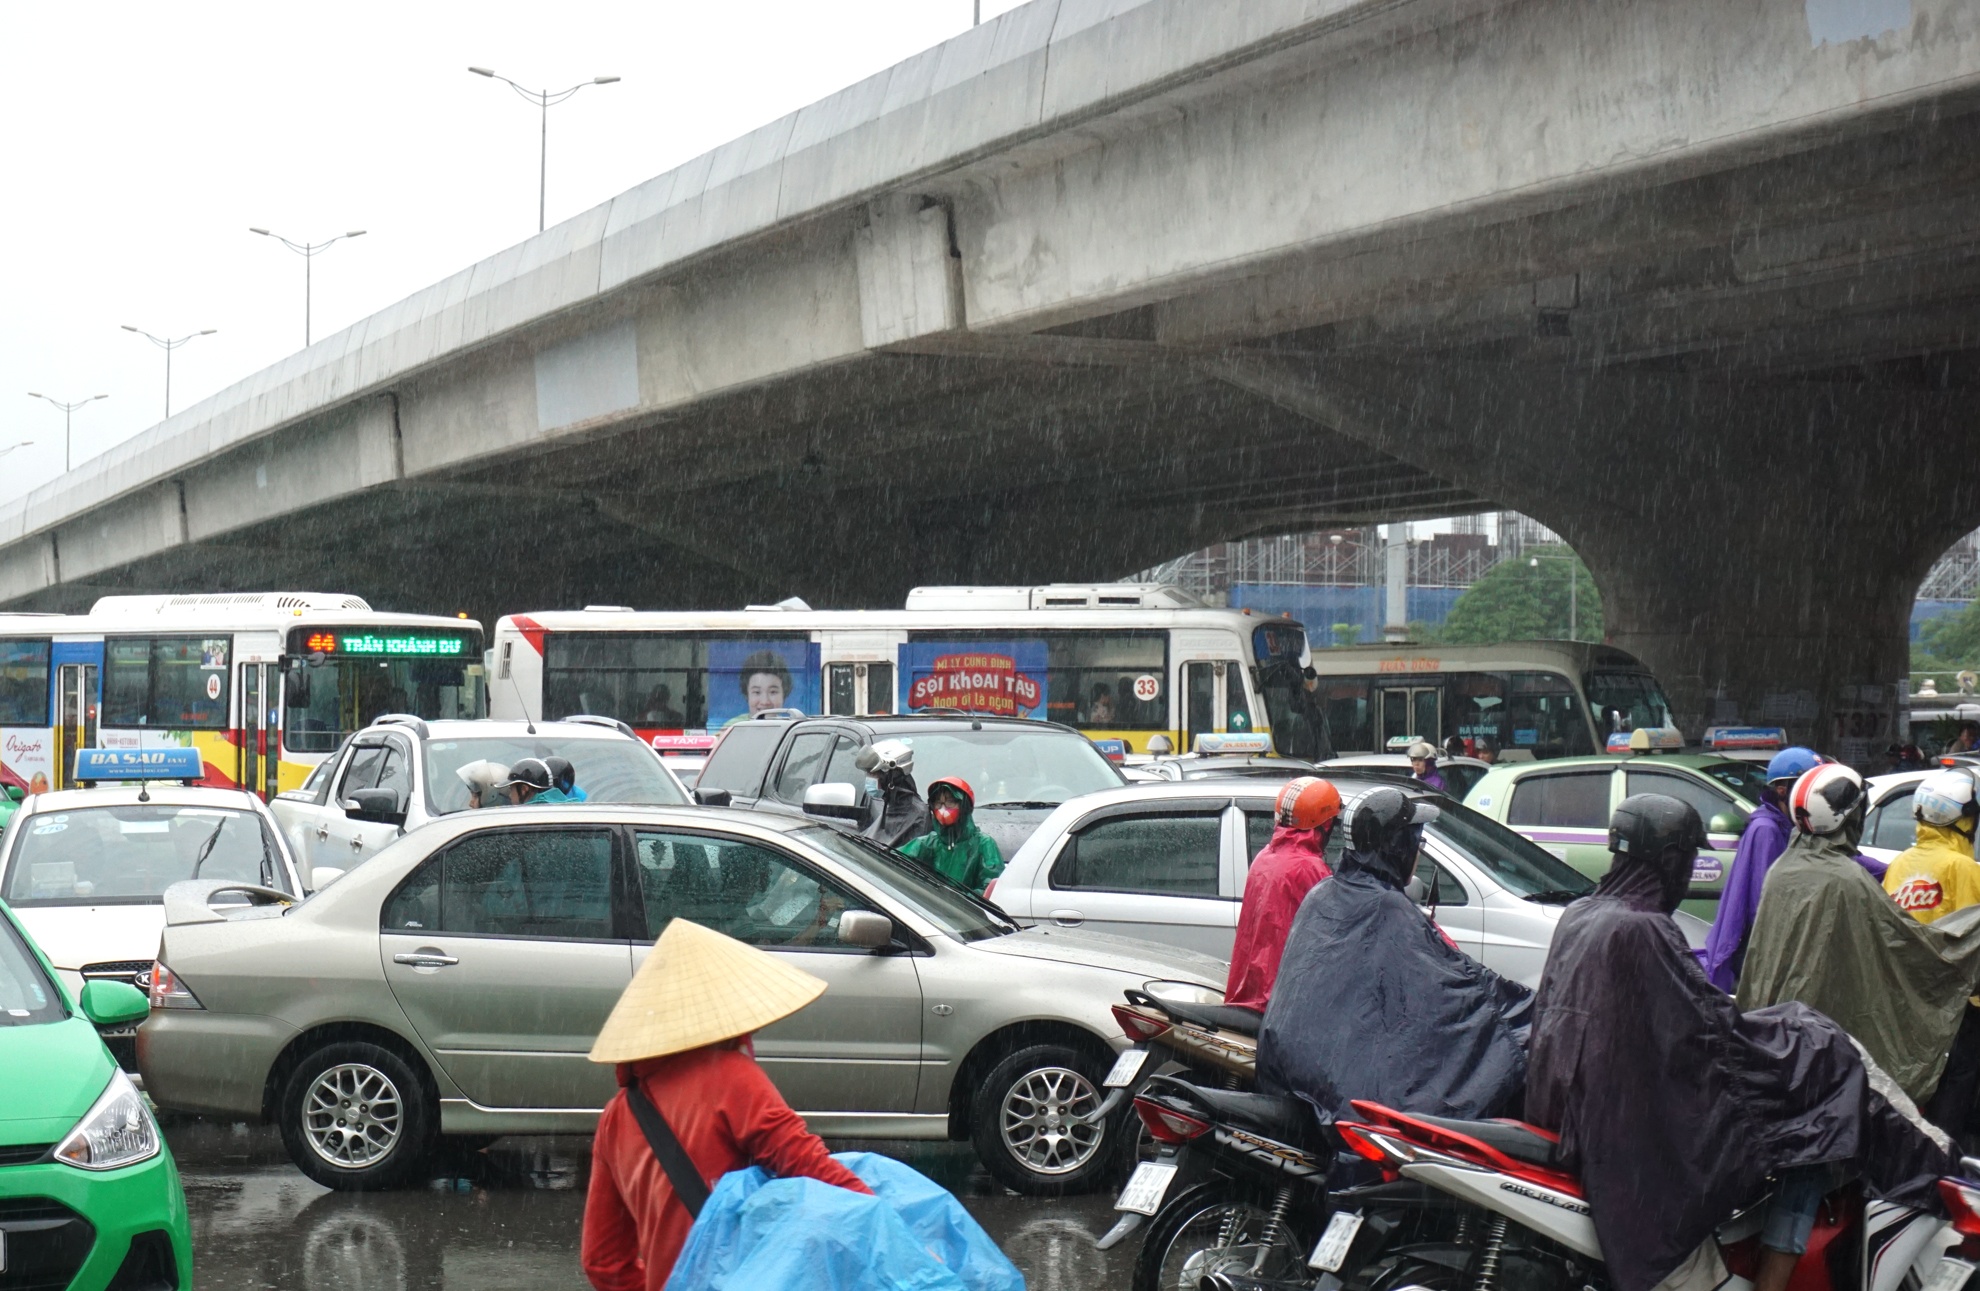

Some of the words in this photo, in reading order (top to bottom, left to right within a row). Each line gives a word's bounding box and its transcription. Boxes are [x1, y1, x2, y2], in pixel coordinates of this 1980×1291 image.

[307, 634, 335, 652] 44
[209, 679, 218, 694] 44
[1137, 679, 1156, 695] 33
[671, 737, 698, 745] TAXI
[90, 753, 119, 765] BA
[123, 752, 165, 765] SAO
[39, 824, 64, 834] 776
[1893, 880, 1940, 910] Poca
[1500, 1181, 1534, 1198] AIR
[1538, 1193, 1590, 1214] BLAD
